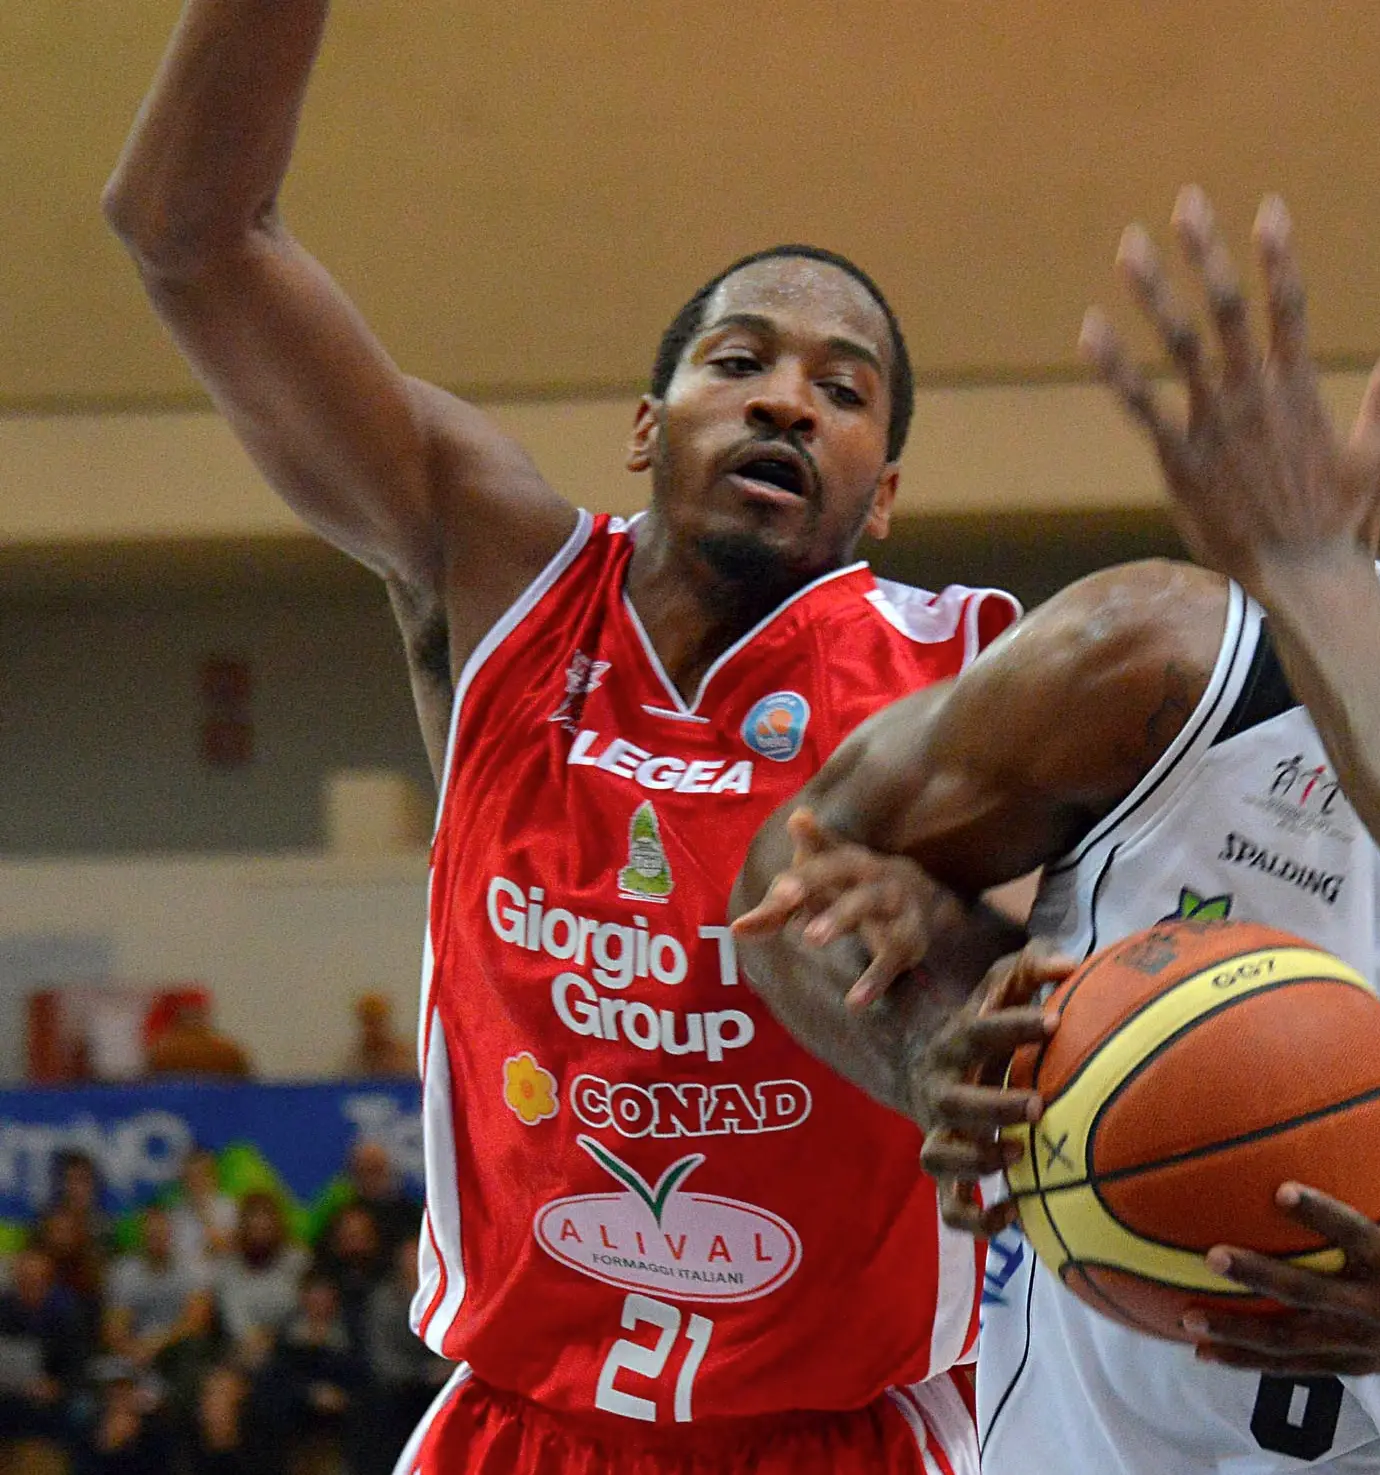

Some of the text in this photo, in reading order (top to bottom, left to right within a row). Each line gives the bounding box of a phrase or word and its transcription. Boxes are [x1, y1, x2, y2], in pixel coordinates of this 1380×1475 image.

[567, 729, 753, 794] LEGEA
[1217, 830, 1345, 904] SPALDING
[487, 876, 688, 989] Giorgio
[551, 972, 755, 1062] Group
[570, 1074, 812, 1138] CONAD
[559, 1218, 774, 1263] ALIVAL
[592, 1253, 744, 1285] FORMAGGI ITALIANI
[595, 1292, 714, 1423] 21
